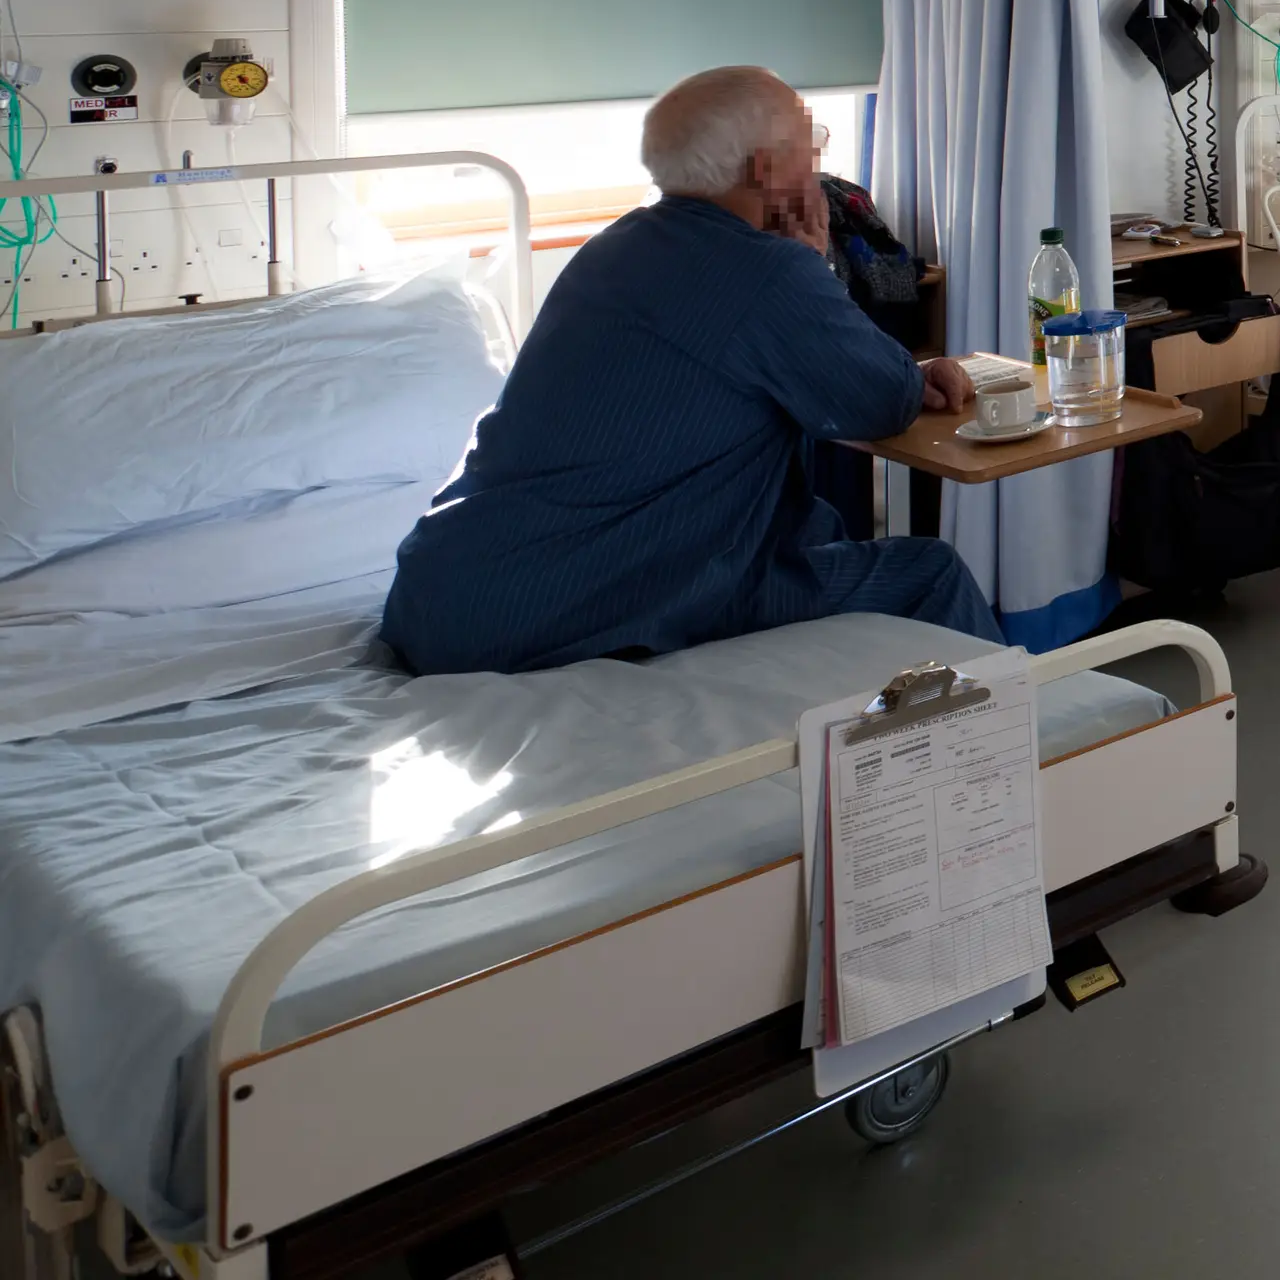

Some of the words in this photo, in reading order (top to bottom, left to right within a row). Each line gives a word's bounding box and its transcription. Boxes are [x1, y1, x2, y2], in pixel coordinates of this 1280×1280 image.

[93, 109, 118, 120] AIR
[893, 725, 916, 736] WEEK
[917, 709, 972, 730] PRESCRIPTION
[973, 701, 998, 714] SHEET
